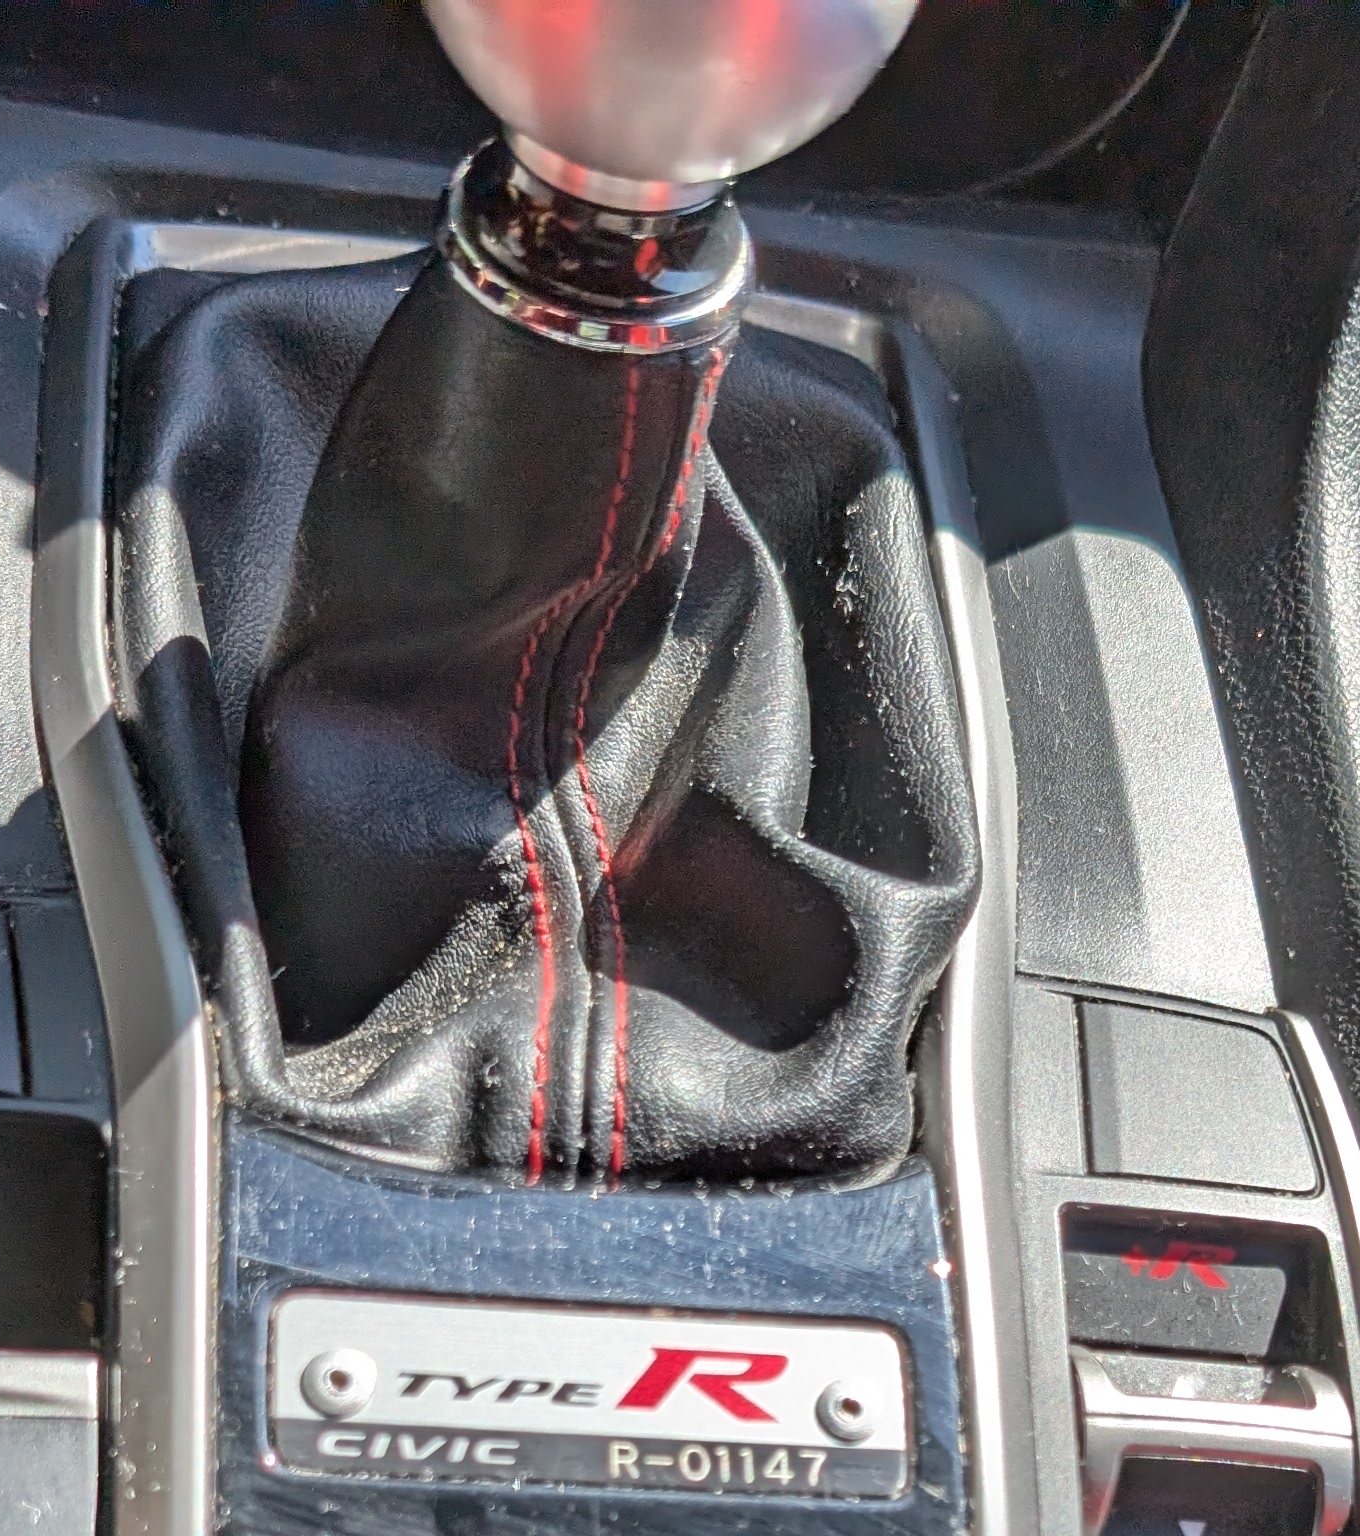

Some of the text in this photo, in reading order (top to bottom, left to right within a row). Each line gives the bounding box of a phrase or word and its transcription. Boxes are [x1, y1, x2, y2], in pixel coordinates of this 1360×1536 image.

[397, 1346, 789, 1423] TYPE R
[316, 1428, 829, 1488] CIVIC R-01147
